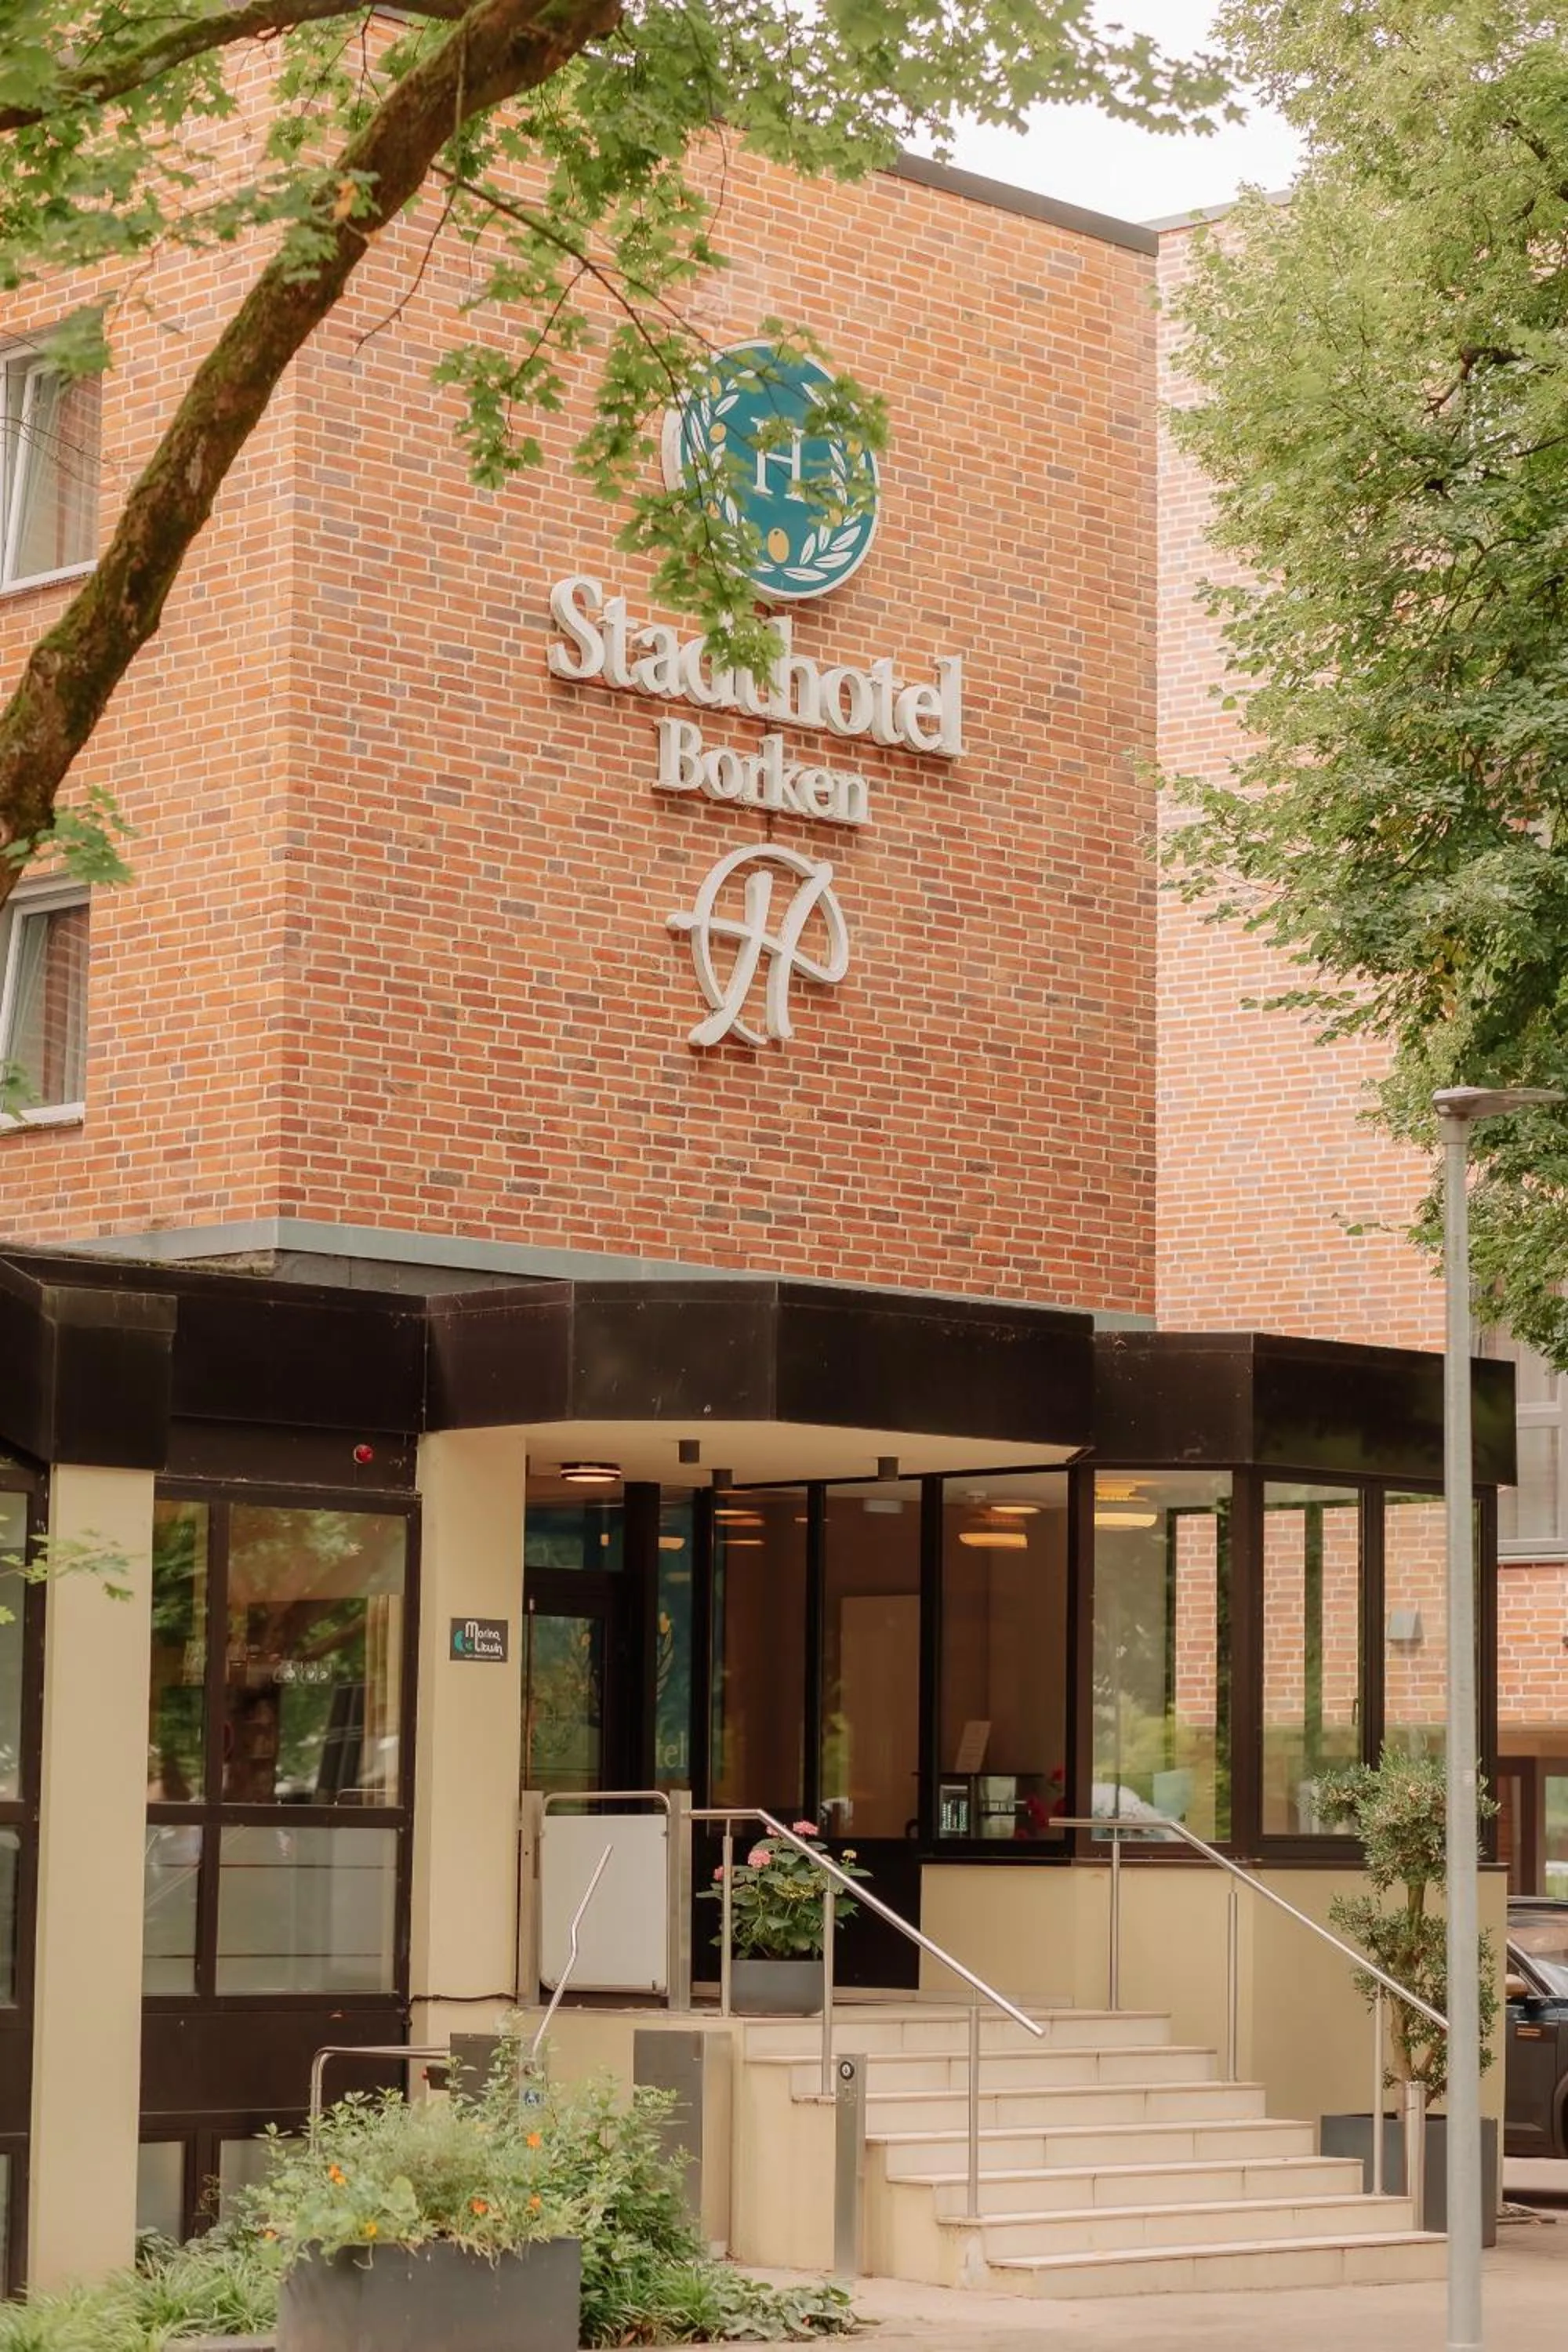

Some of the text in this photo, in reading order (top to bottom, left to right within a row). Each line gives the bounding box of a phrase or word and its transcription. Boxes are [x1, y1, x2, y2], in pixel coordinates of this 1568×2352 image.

[749, 416, 808, 503] H
[652, 717, 872, 824] Borken
[465, 1621, 501, 1642] Marina
